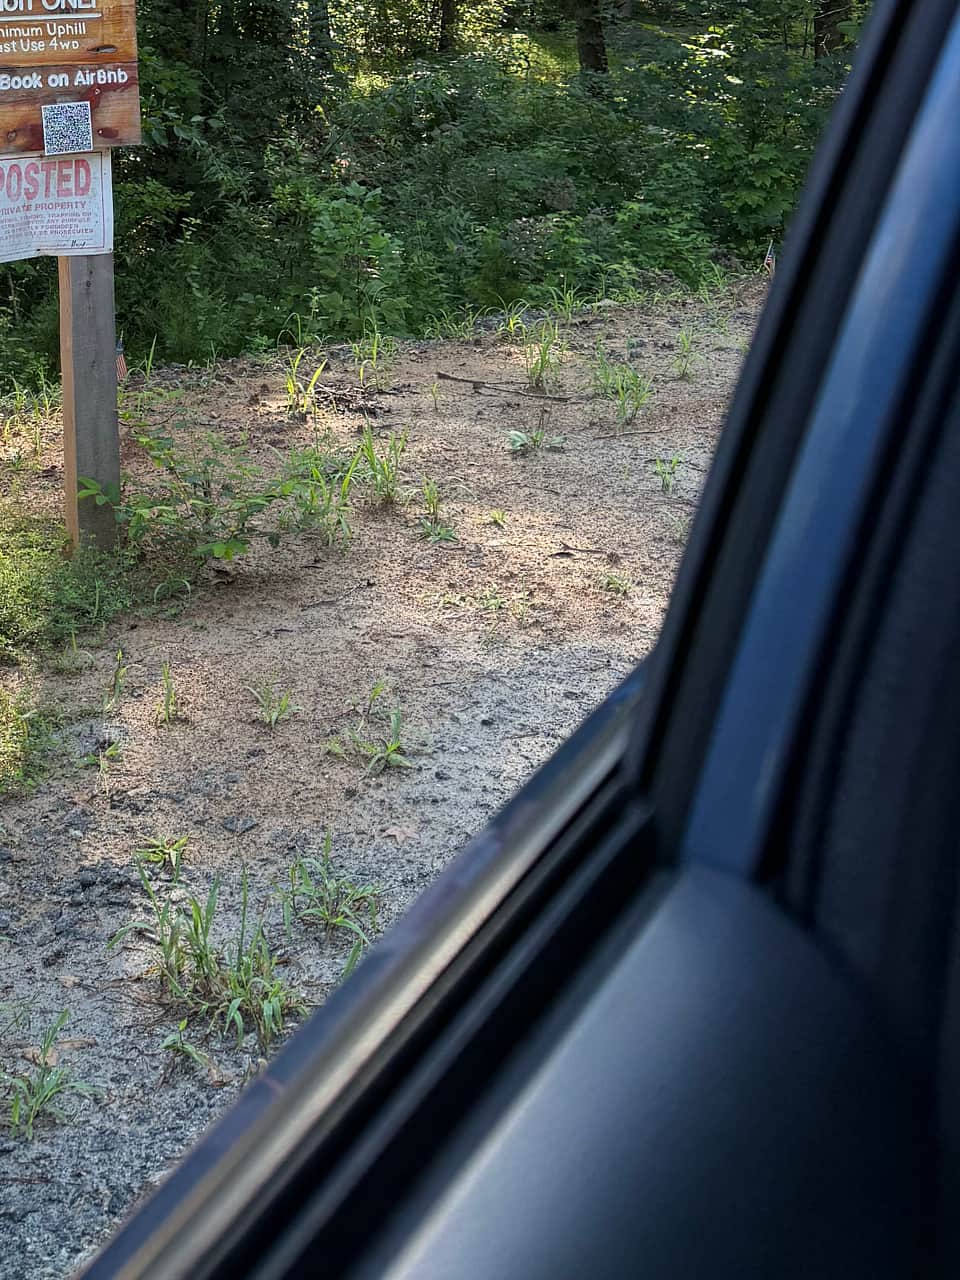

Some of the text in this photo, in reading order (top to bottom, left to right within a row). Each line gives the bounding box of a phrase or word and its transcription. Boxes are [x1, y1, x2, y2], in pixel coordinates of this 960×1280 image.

[46, 22, 86, 37] Uphill
[20, 39, 45, 53] Use
[47, 73, 69, 87] on
[34, 200, 87, 212] PROPERTY
